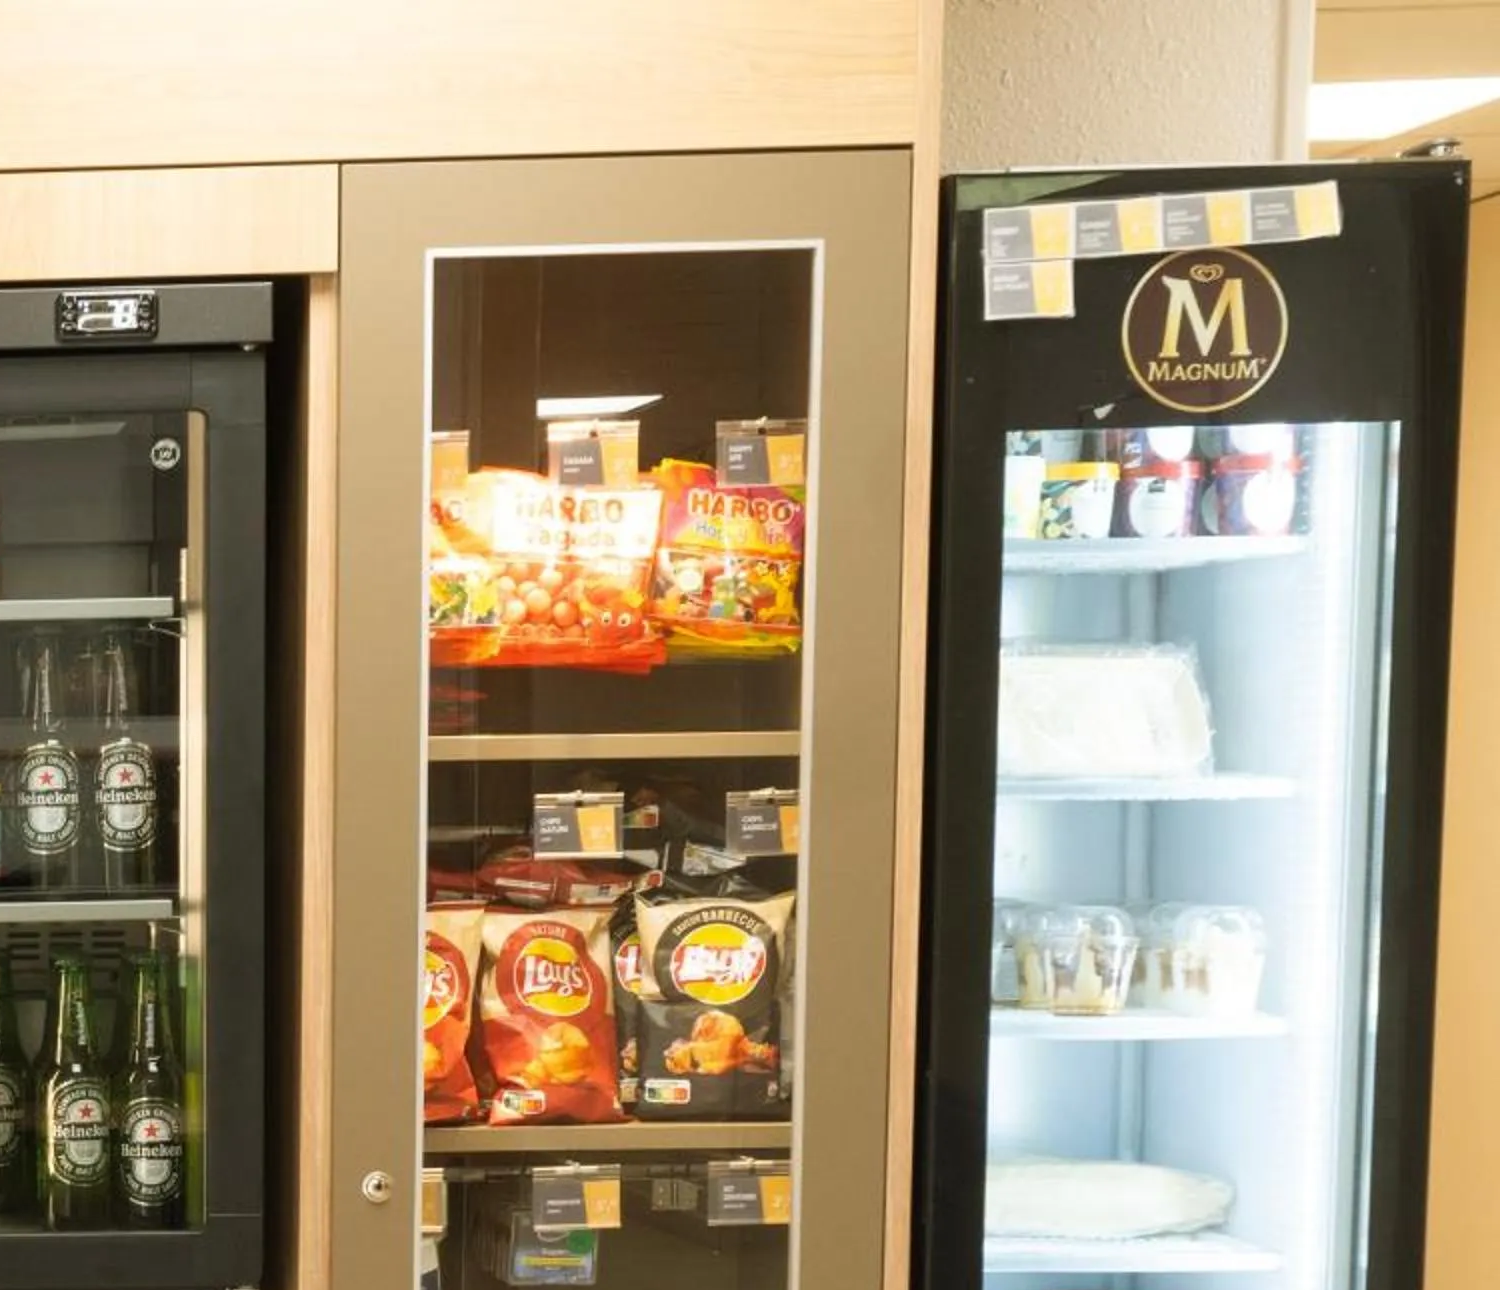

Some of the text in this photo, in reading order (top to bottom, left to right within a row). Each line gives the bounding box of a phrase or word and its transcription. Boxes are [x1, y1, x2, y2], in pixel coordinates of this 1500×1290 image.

[1147, 360, 1262, 382] MAGNUM
[688, 487, 795, 526] HARIBO
[523, 954, 585, 997] Lay's
